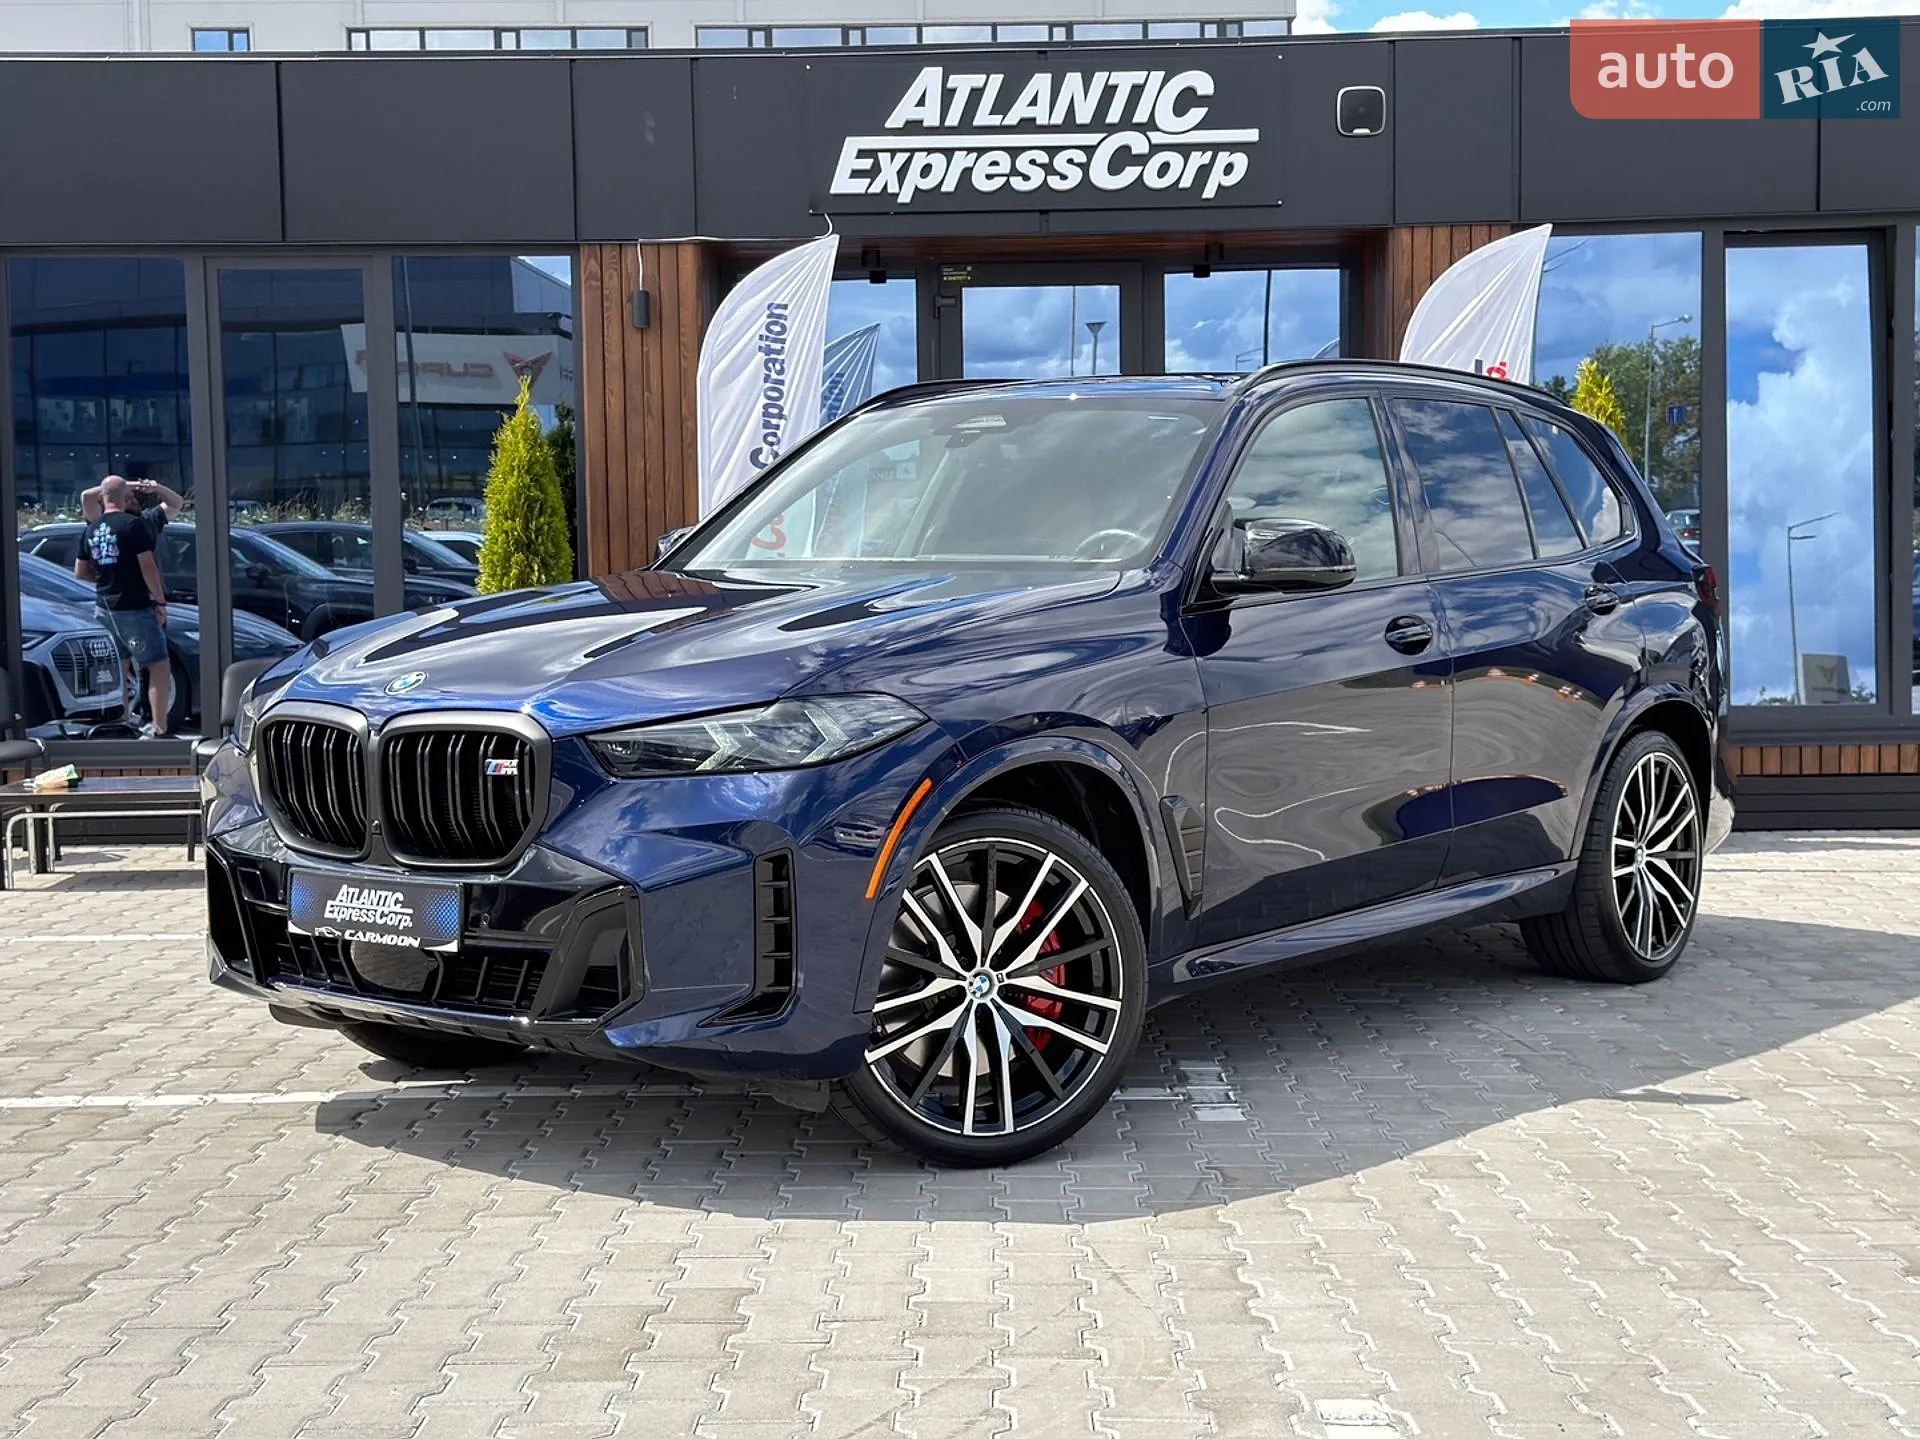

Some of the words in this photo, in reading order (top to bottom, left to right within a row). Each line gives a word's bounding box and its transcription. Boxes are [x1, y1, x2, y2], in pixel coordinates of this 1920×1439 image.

[885, 66, 1215, 132] ATLANTIC
[829, 130, 1250, 203] ExpressCorp
[750, 301, 789, 471] Corporation
[335, 883, 405, 909] ATLANTIC
[344, 929, 421, 949] CARMOON
